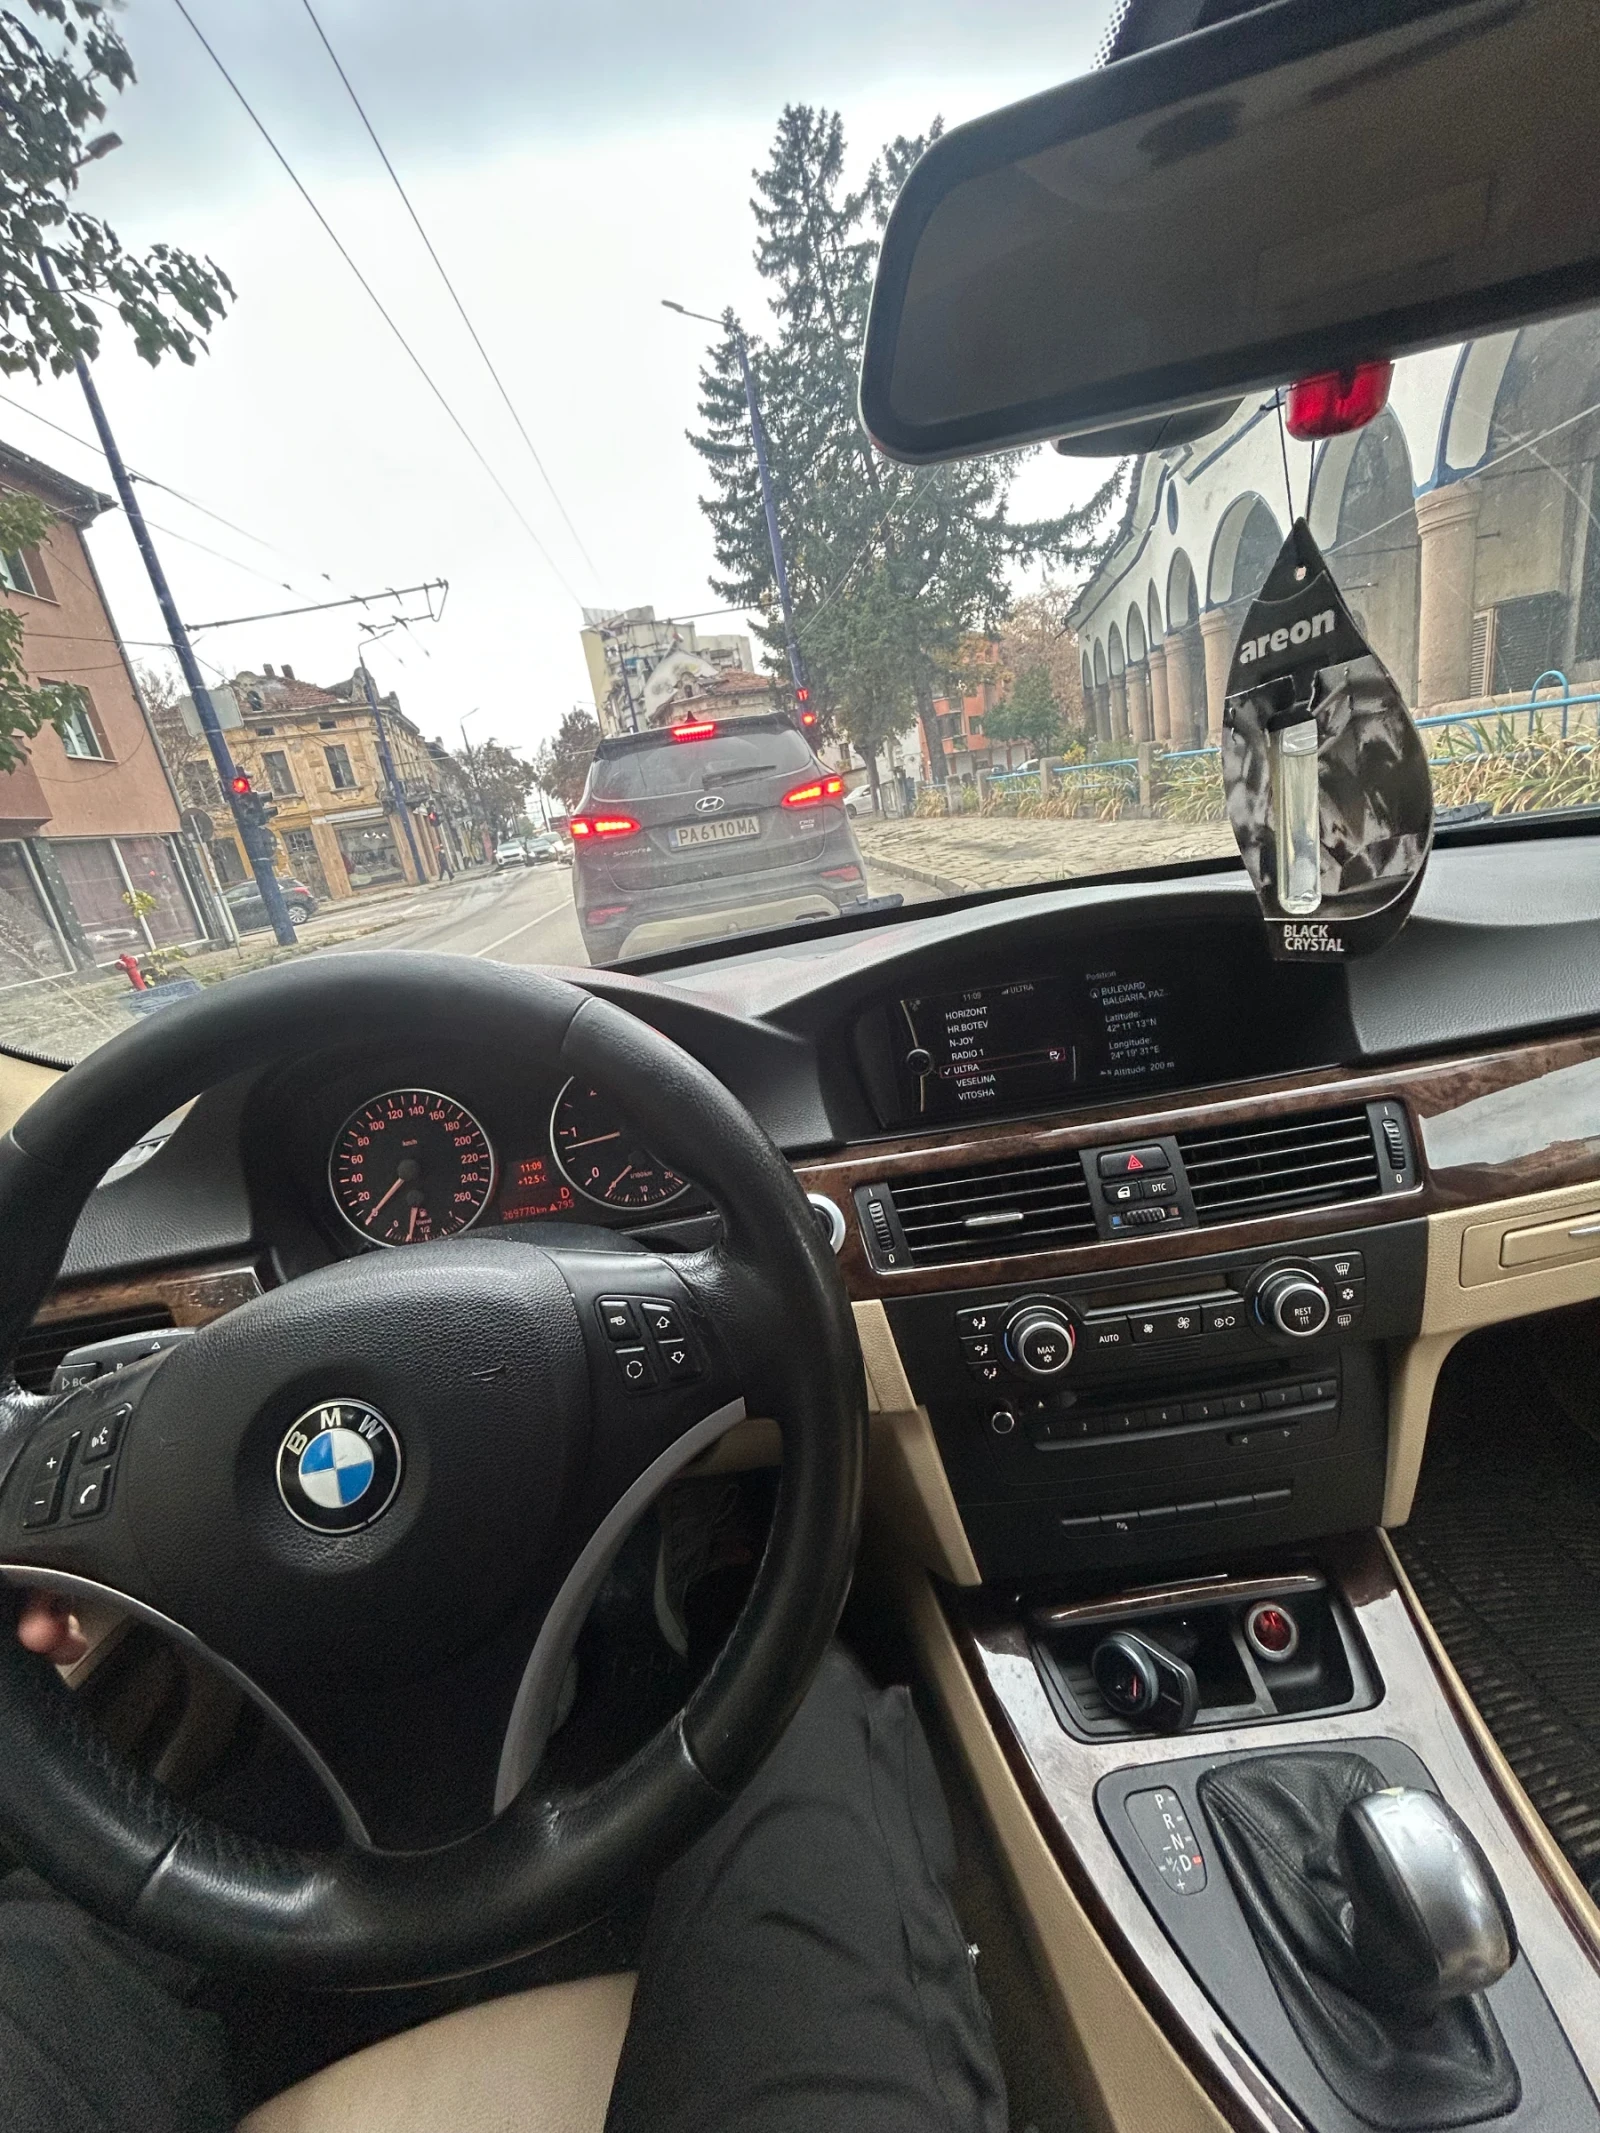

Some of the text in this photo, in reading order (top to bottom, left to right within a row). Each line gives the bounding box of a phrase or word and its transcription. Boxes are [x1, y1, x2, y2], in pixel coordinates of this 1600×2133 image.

[1240, 609, 1335, 664] areon
[678, 818, 756, 845] PA 6110 MA
[1283, 924, 1329, 938] BLACK
[1284, 937, 1345, 952] CRYSTAL
[1085, 970, 1117, 981] Position
[1009, 983, 1034, 994] ULTRA
[1101, 981, 1146, 996] BULEVARD
[963, 991, 982, 1002] 11:09
[945, 1006, 988, 1021] HORIZONT
[1105, 1011, 1141, 1023] Latitude:
[947, 1020, 989, 1034] HR.BOTEV
[949, 1036, 974, 1048] N-JOY
[1108, 1037, 1152, 1051] Longitude:
[951, 1050, 977, 1061] RADIO
[953, 1063, 980, 1075] ULTRA
[1150, 1062, 1165, 1072] 200
[956, 1074, 996, 1088] VESELINA
[958, 1088, 995, 1101] VITOSHA
[387, 1109, 404, 1120] 120
[408, 1105, 425, 1116] 140
[428, 1110, 446, 1121] 160
[368, 1120, 385, 1131] 100
[443, 1121, 460, 1132] 180
[571, 1126, 577, 1138] 1
[357, 1136, 370, 1147] 80
[454, 1135, 472, 1147] 200
[351, 1154, 363, 1165] 60
[460, 1153, 479, 1165] 220
[520, 1160, 542, 1173] 11:09
[591, 1166, 600, 1178] 0
[351, 1173, 363, 1184] 40
[460, 1172, 479, 1184] 240
[663, 1171, 674, 1179] 20
[560, 1186, 570, 1199] D
[640, 1184, 648, 1193] 10
[1151, 1182, 1167, 1193] DTC
[358, 1191, 370, 1202] 20
[453, 1191, 472, 1203] 260
[393, 1219, 399, 1228] 0
[420, 1226, 431, 1234] 1/2
[1294, 1306, 1312, 1316] REST
[1099, 1333, 1120, 1344] AUTO
[1036, 1345, 1056, 1355] MAX
[72, 1376, 87, 1388] BC
[286, 1407, 384, 1456] BMW
[1154, 1794, 1164, 1810] P
[1162, 1813, 1176, 1830] R
[1170, 1832, 1185, 1851] N
[1178, 1854, 1192, 1872] D
